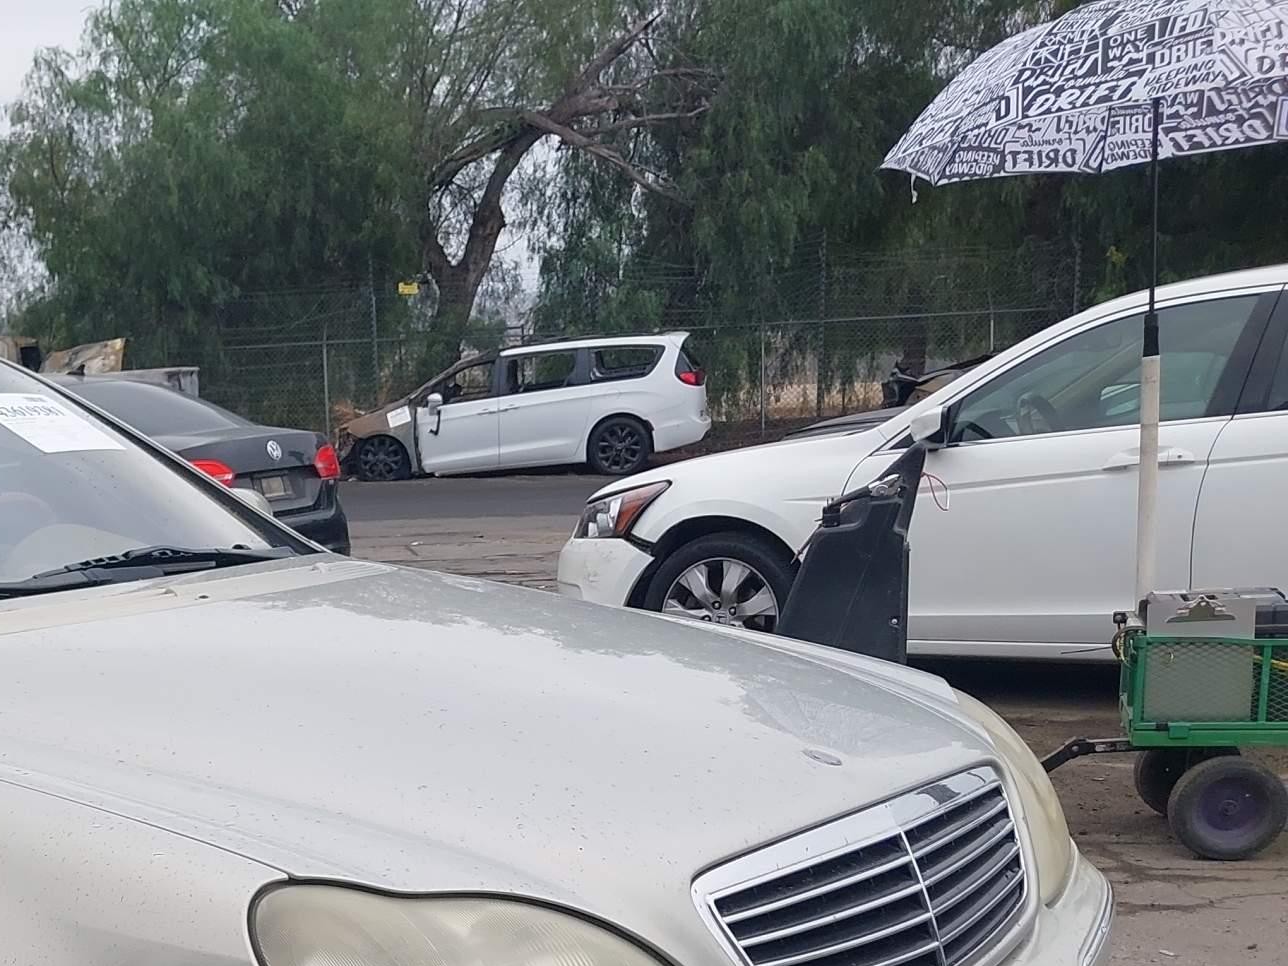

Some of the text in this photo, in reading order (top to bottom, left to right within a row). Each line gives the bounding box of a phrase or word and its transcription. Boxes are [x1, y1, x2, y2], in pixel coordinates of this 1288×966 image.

[1109, 27, 1148, 47] ONE
[1108, 39, 1149, 60] WAY
[1024, 78, 1138, 116] DRIFT
